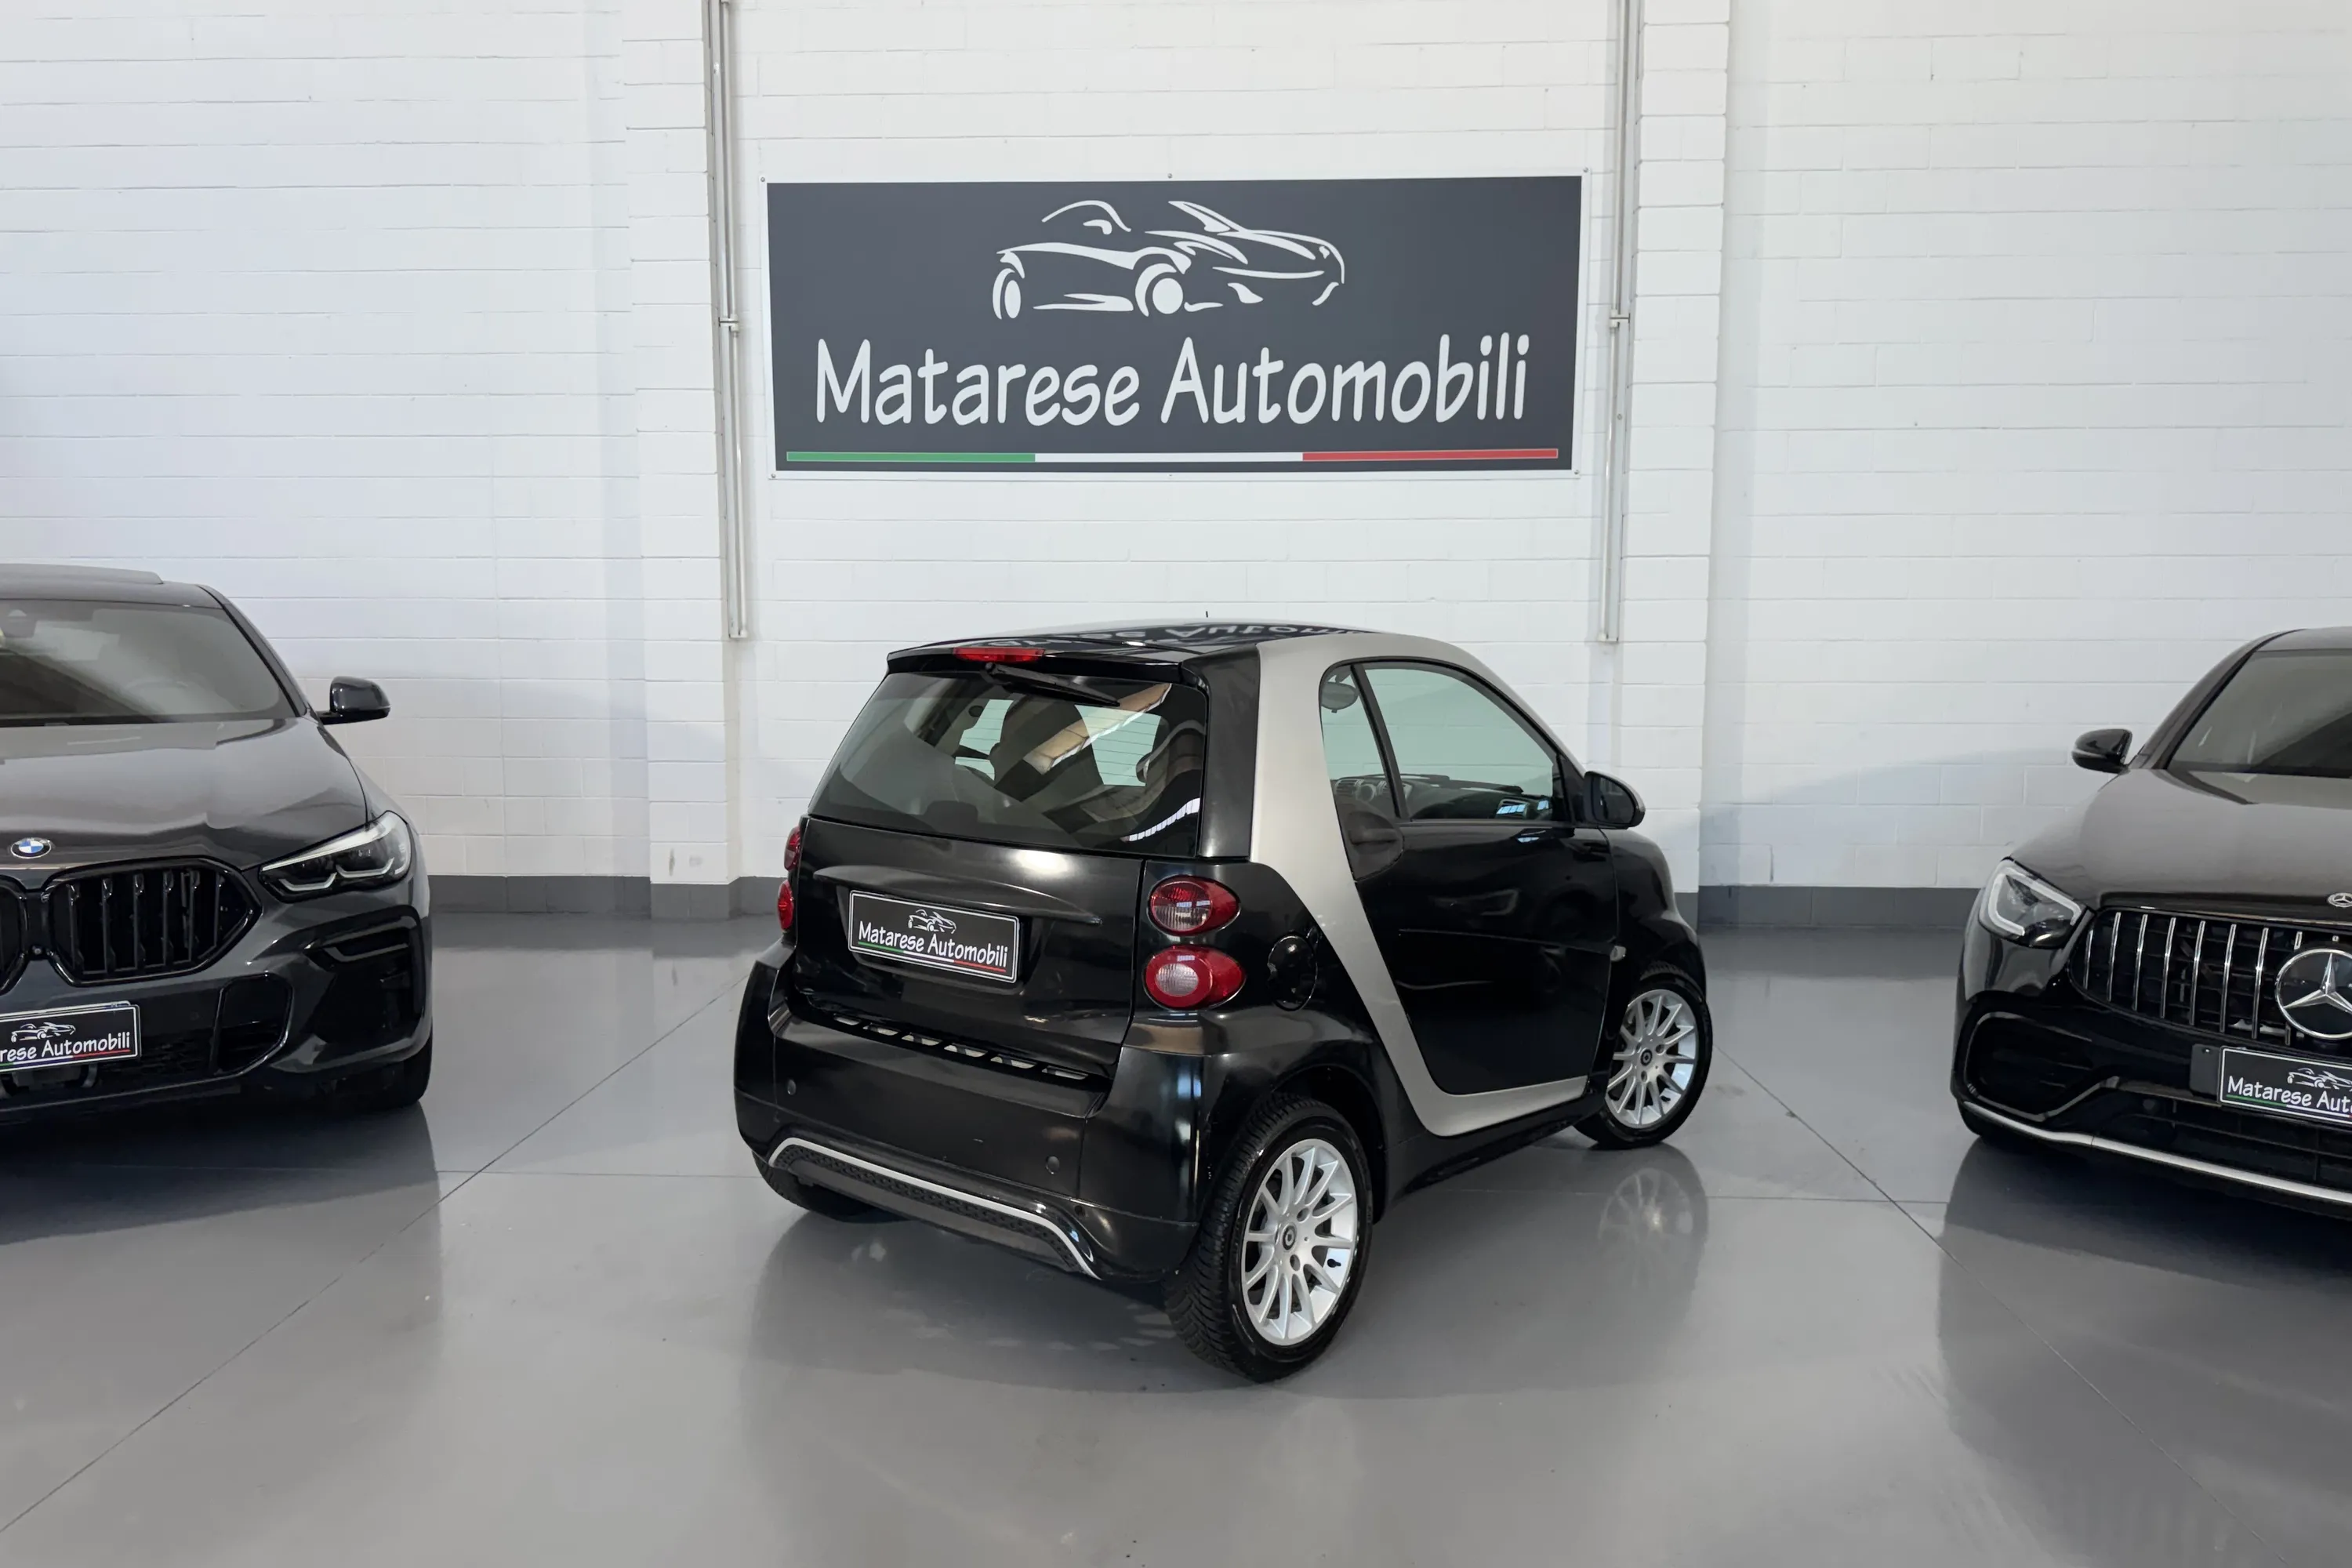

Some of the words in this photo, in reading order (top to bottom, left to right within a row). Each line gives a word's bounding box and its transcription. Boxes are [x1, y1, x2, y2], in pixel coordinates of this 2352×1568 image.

[815, 338, 1140, 426] Matarese
[1160, 332, 1530, 426] Automobili
[858, 920, 924, 953] Matarese
[927, 933, 1008, 967] Automobili
[42, 1032, 130, 1058] Automobili
[2227, 1076, 2312, 1107] Matarese
[2316, 1090, 2352, 1113] Aut
